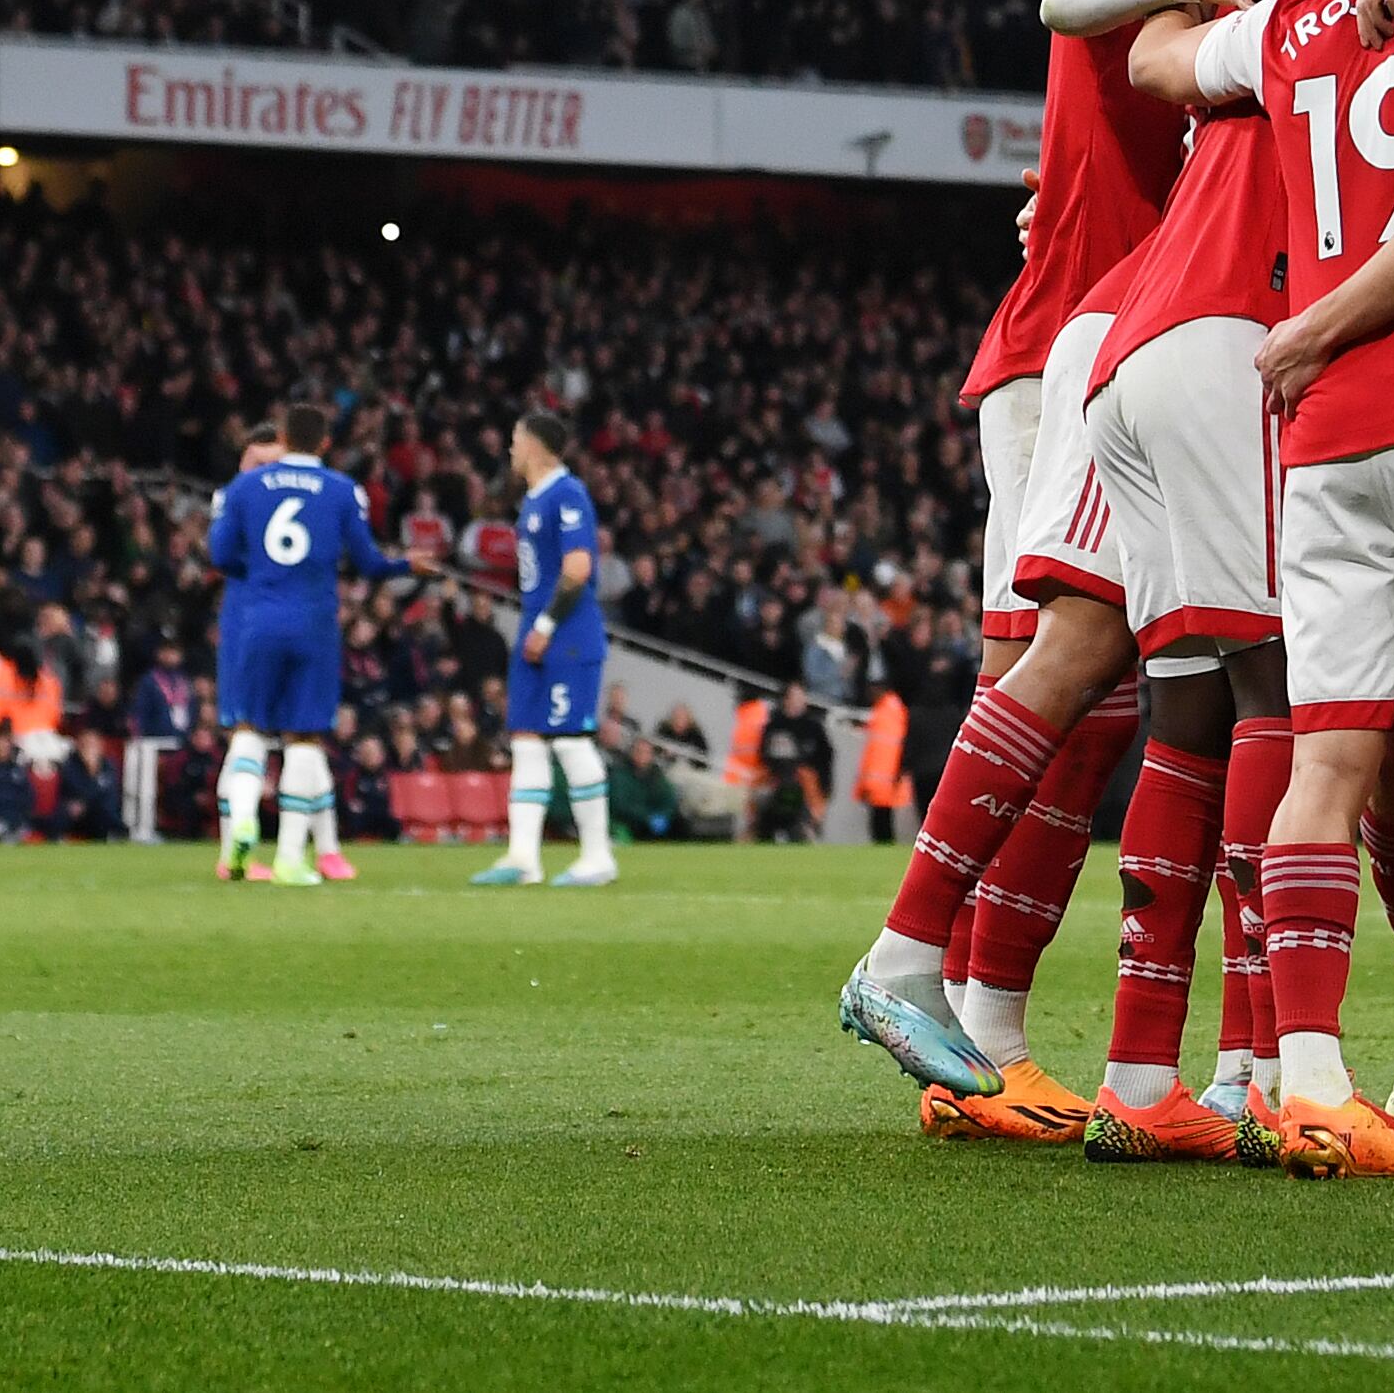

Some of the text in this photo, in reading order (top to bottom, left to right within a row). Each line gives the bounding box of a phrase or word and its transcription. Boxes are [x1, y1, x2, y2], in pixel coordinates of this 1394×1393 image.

[125, 63, 584, 149] Emirates FLY BETTER
[263, 497, 311, 566] 6
[548, 682, 572, 726] 5
